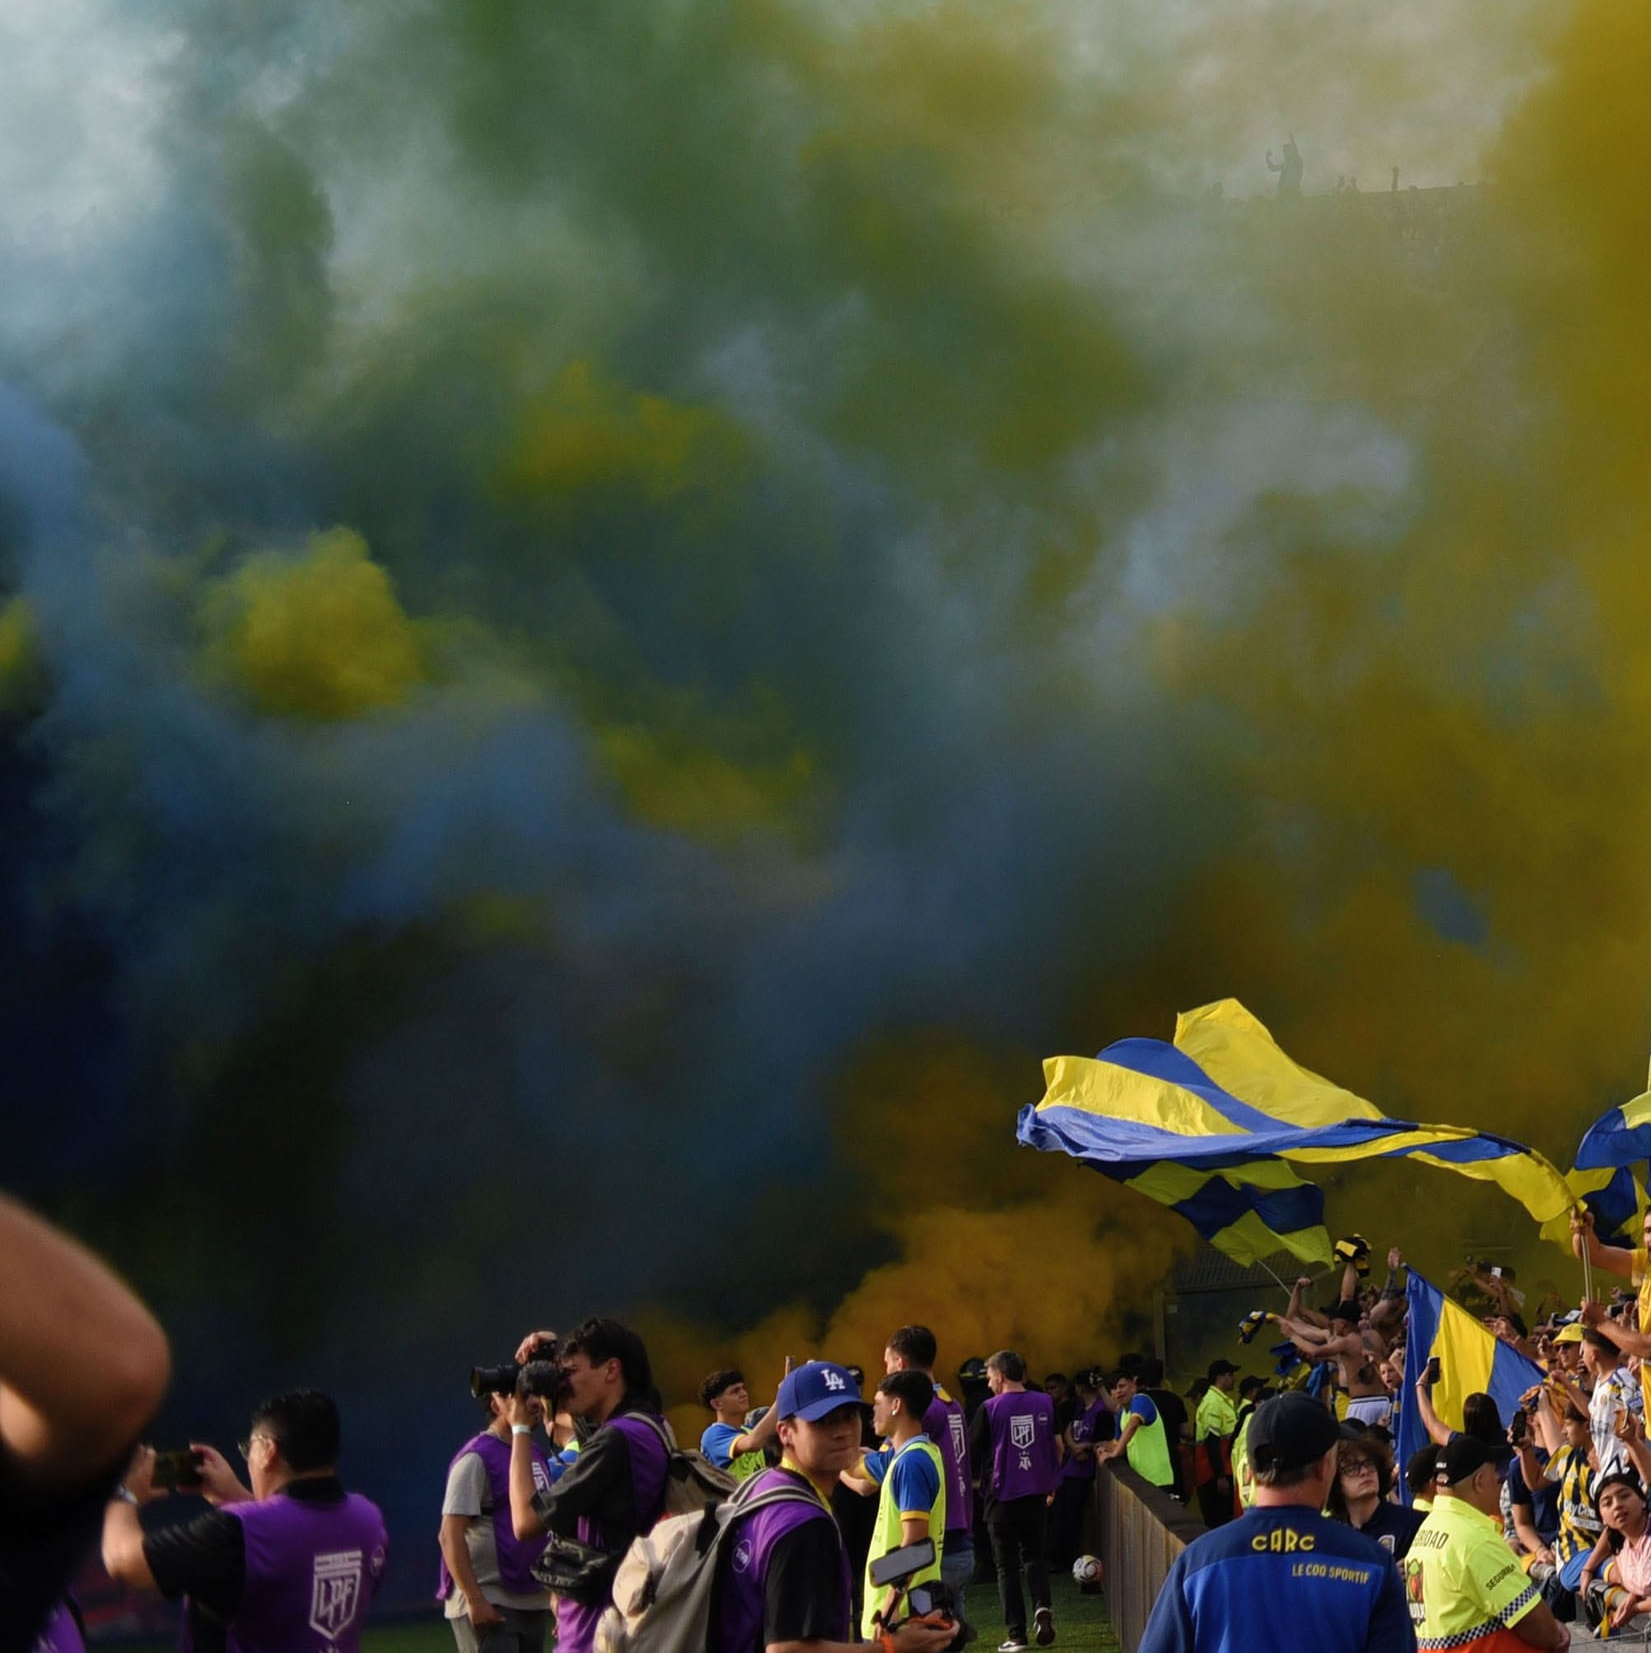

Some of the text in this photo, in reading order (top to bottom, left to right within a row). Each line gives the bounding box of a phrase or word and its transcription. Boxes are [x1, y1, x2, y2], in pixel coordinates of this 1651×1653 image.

[821, 1368, 845, 1391] LA
[1252, 1527, 1314, 1553] CARC
[1292, 1564, 1369, 1585] LE COQ SPORTIF
